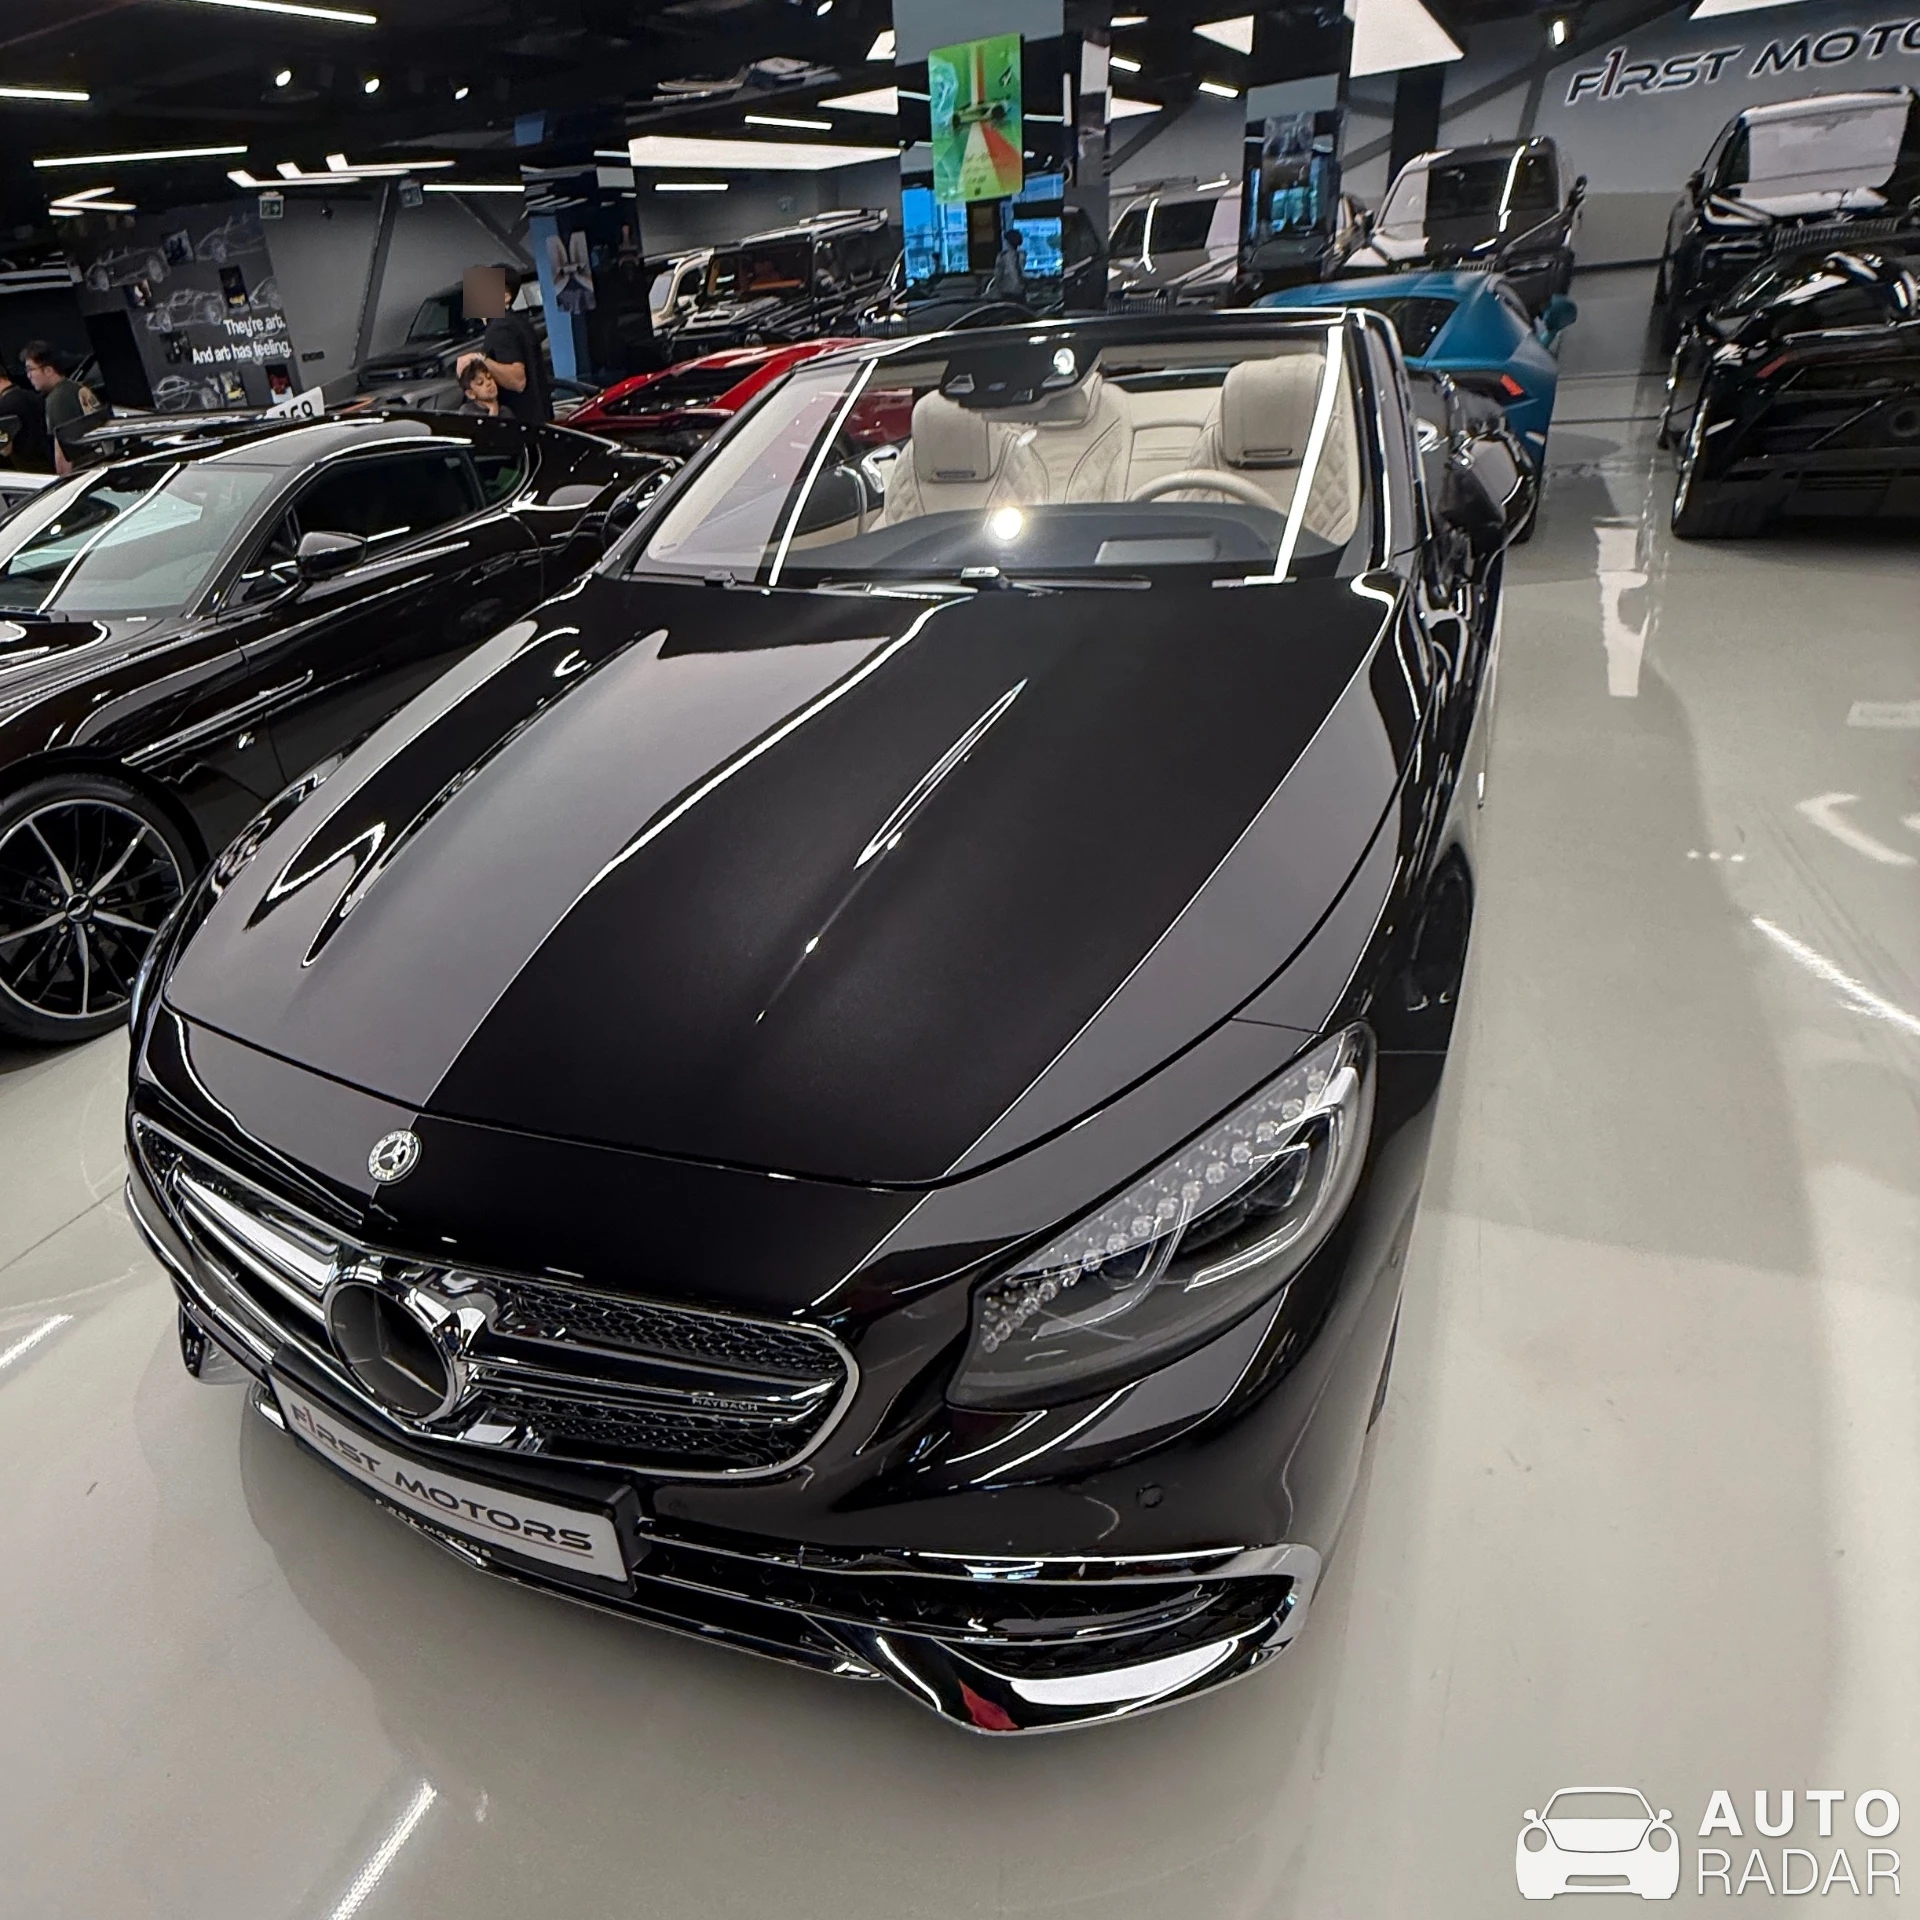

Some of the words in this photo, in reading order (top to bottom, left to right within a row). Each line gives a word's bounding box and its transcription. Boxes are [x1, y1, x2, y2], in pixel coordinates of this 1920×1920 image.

[223, 316, 264, 338] They're
[192, 346, 214, 365] And
[214, 345, 231, 362] art
[231, 343, 252, 360] has
[252, 339, 292, 358] feeling.
[692, 1396, 758, 1411] MAYBACH
[395, 1471, 593, 1552] MOTORS
